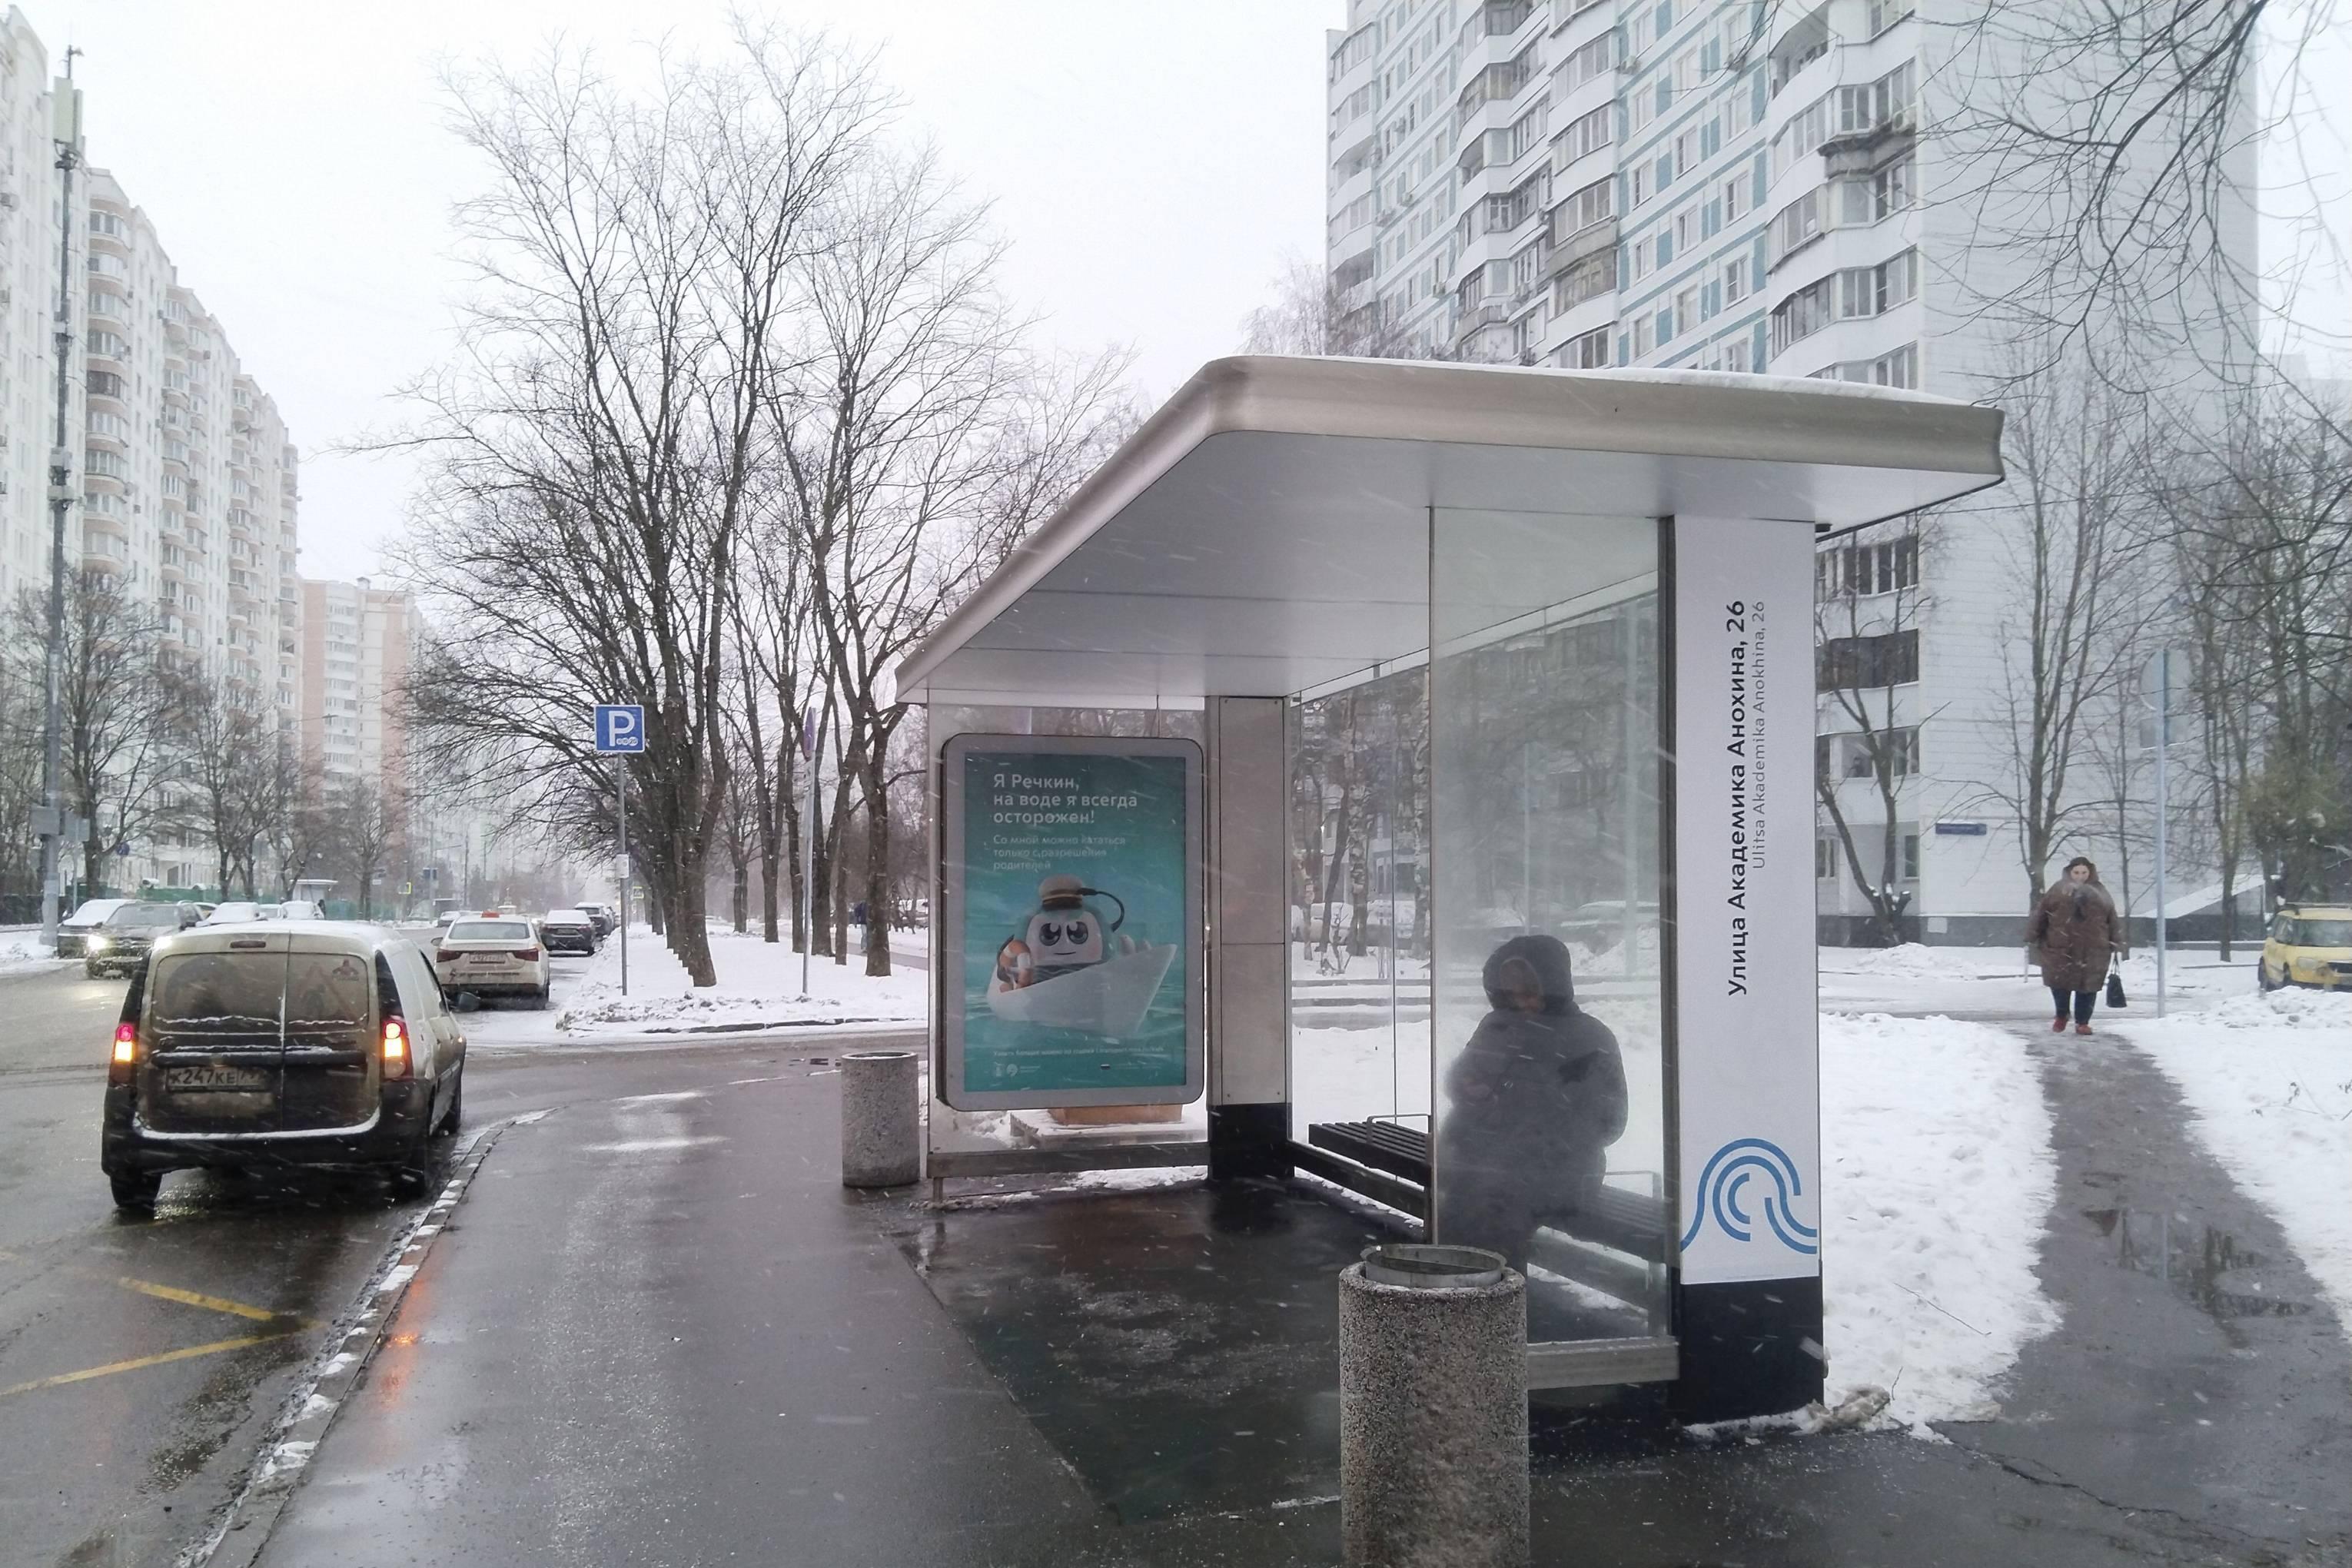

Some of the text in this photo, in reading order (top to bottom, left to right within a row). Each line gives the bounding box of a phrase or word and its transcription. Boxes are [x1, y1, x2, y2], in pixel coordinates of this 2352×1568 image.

[608, 710, 635, 747] P
[1751, 601, 1766, 869] Ulitsa Akademika Anokhina, 26
[993, 773, 1080, 792] Я Речкин,
[993, 795, 1138, 809] на воде я всегда
[1726, 600, 1749, 996] Улица Академика Анохина, 26
[993, 809, 1095, 827] осторожен!
[993, 834, 1008, 845] Со
[1010, 834, 1038, 845] мной
[1041, 835, 1079, 845] можно
[993, 848, 1031, 858] только
